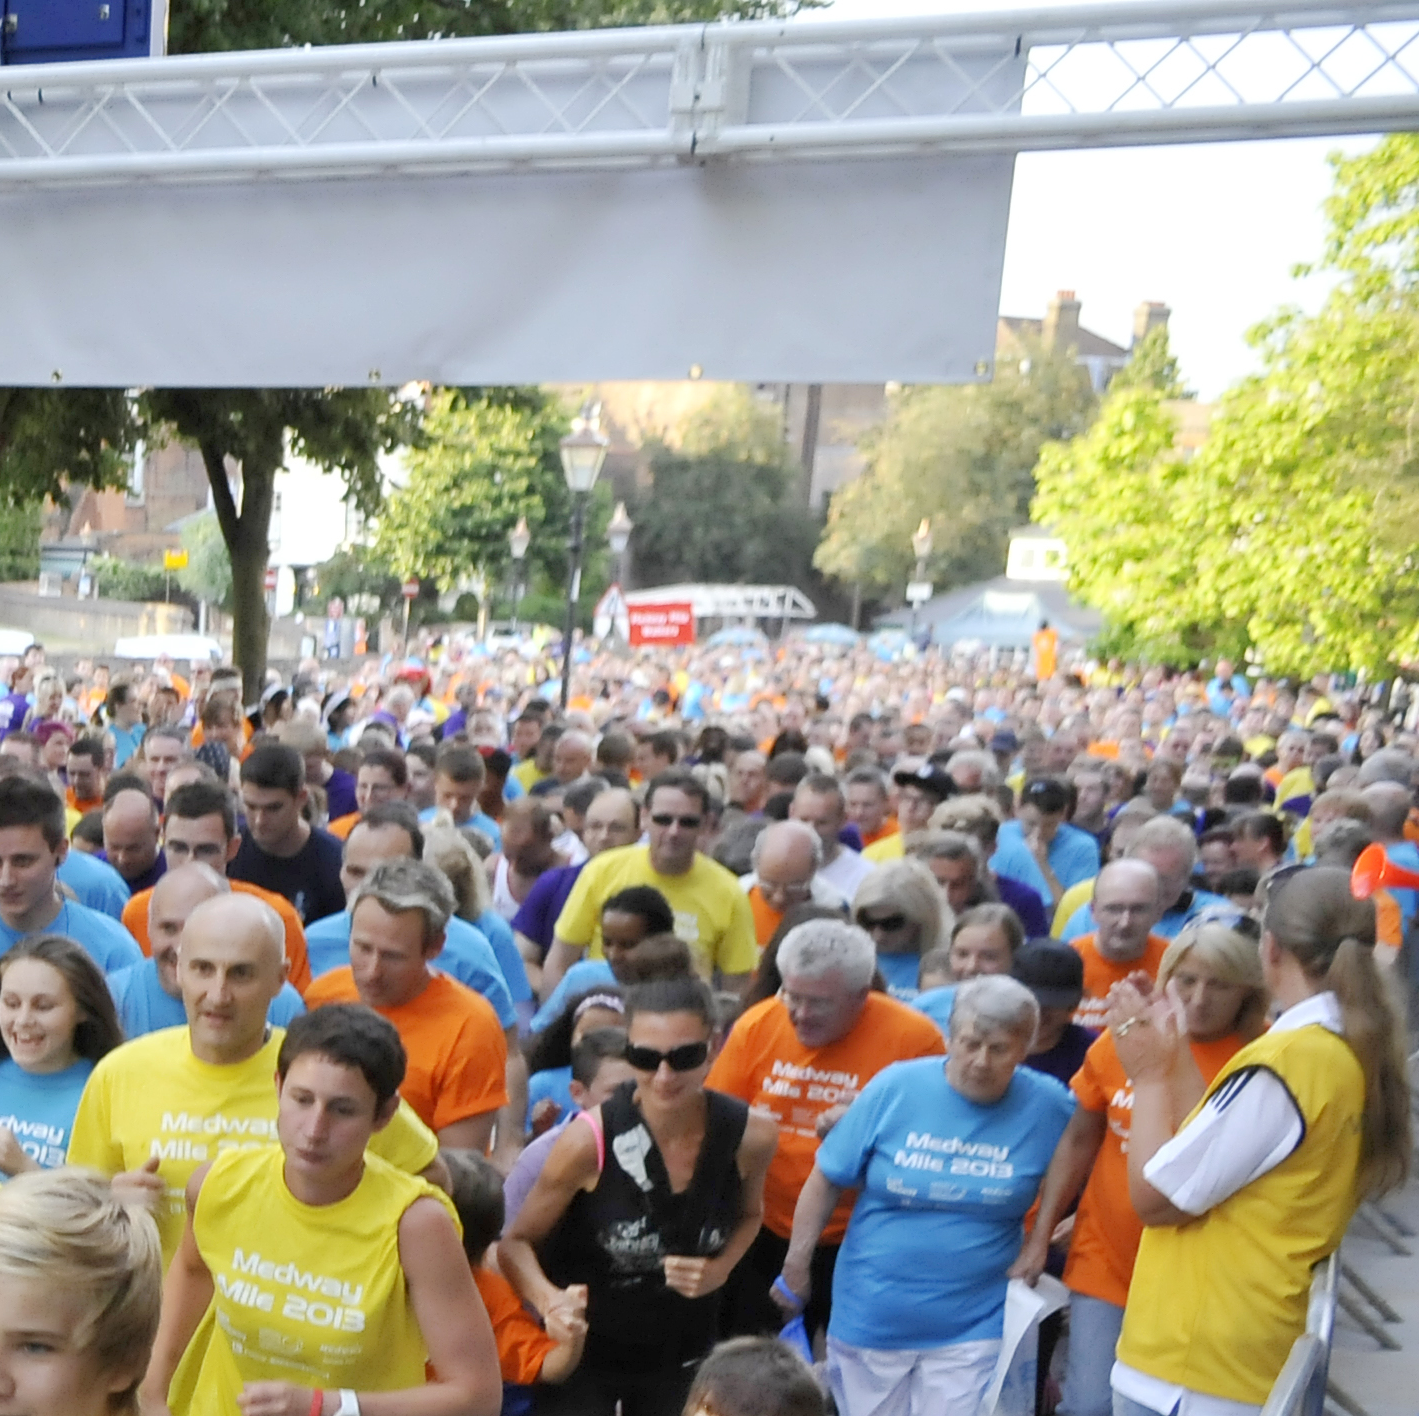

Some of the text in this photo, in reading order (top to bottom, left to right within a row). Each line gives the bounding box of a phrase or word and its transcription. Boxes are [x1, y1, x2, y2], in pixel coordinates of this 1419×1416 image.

[763, 1077, 801, 1098] Mile
[772, 1060, 859, 1088] Medway
[22, 1140, 65, 1166] 013
[150, 1138, 207, 1160] Mile
[906, 1131, 1009, 1162] Medway
[894, 1150, 1013, 1178] Mile 2013
[232, 1247, 363, 1306] Medway
[217, 1273, 365, 1333] Mile 2013
